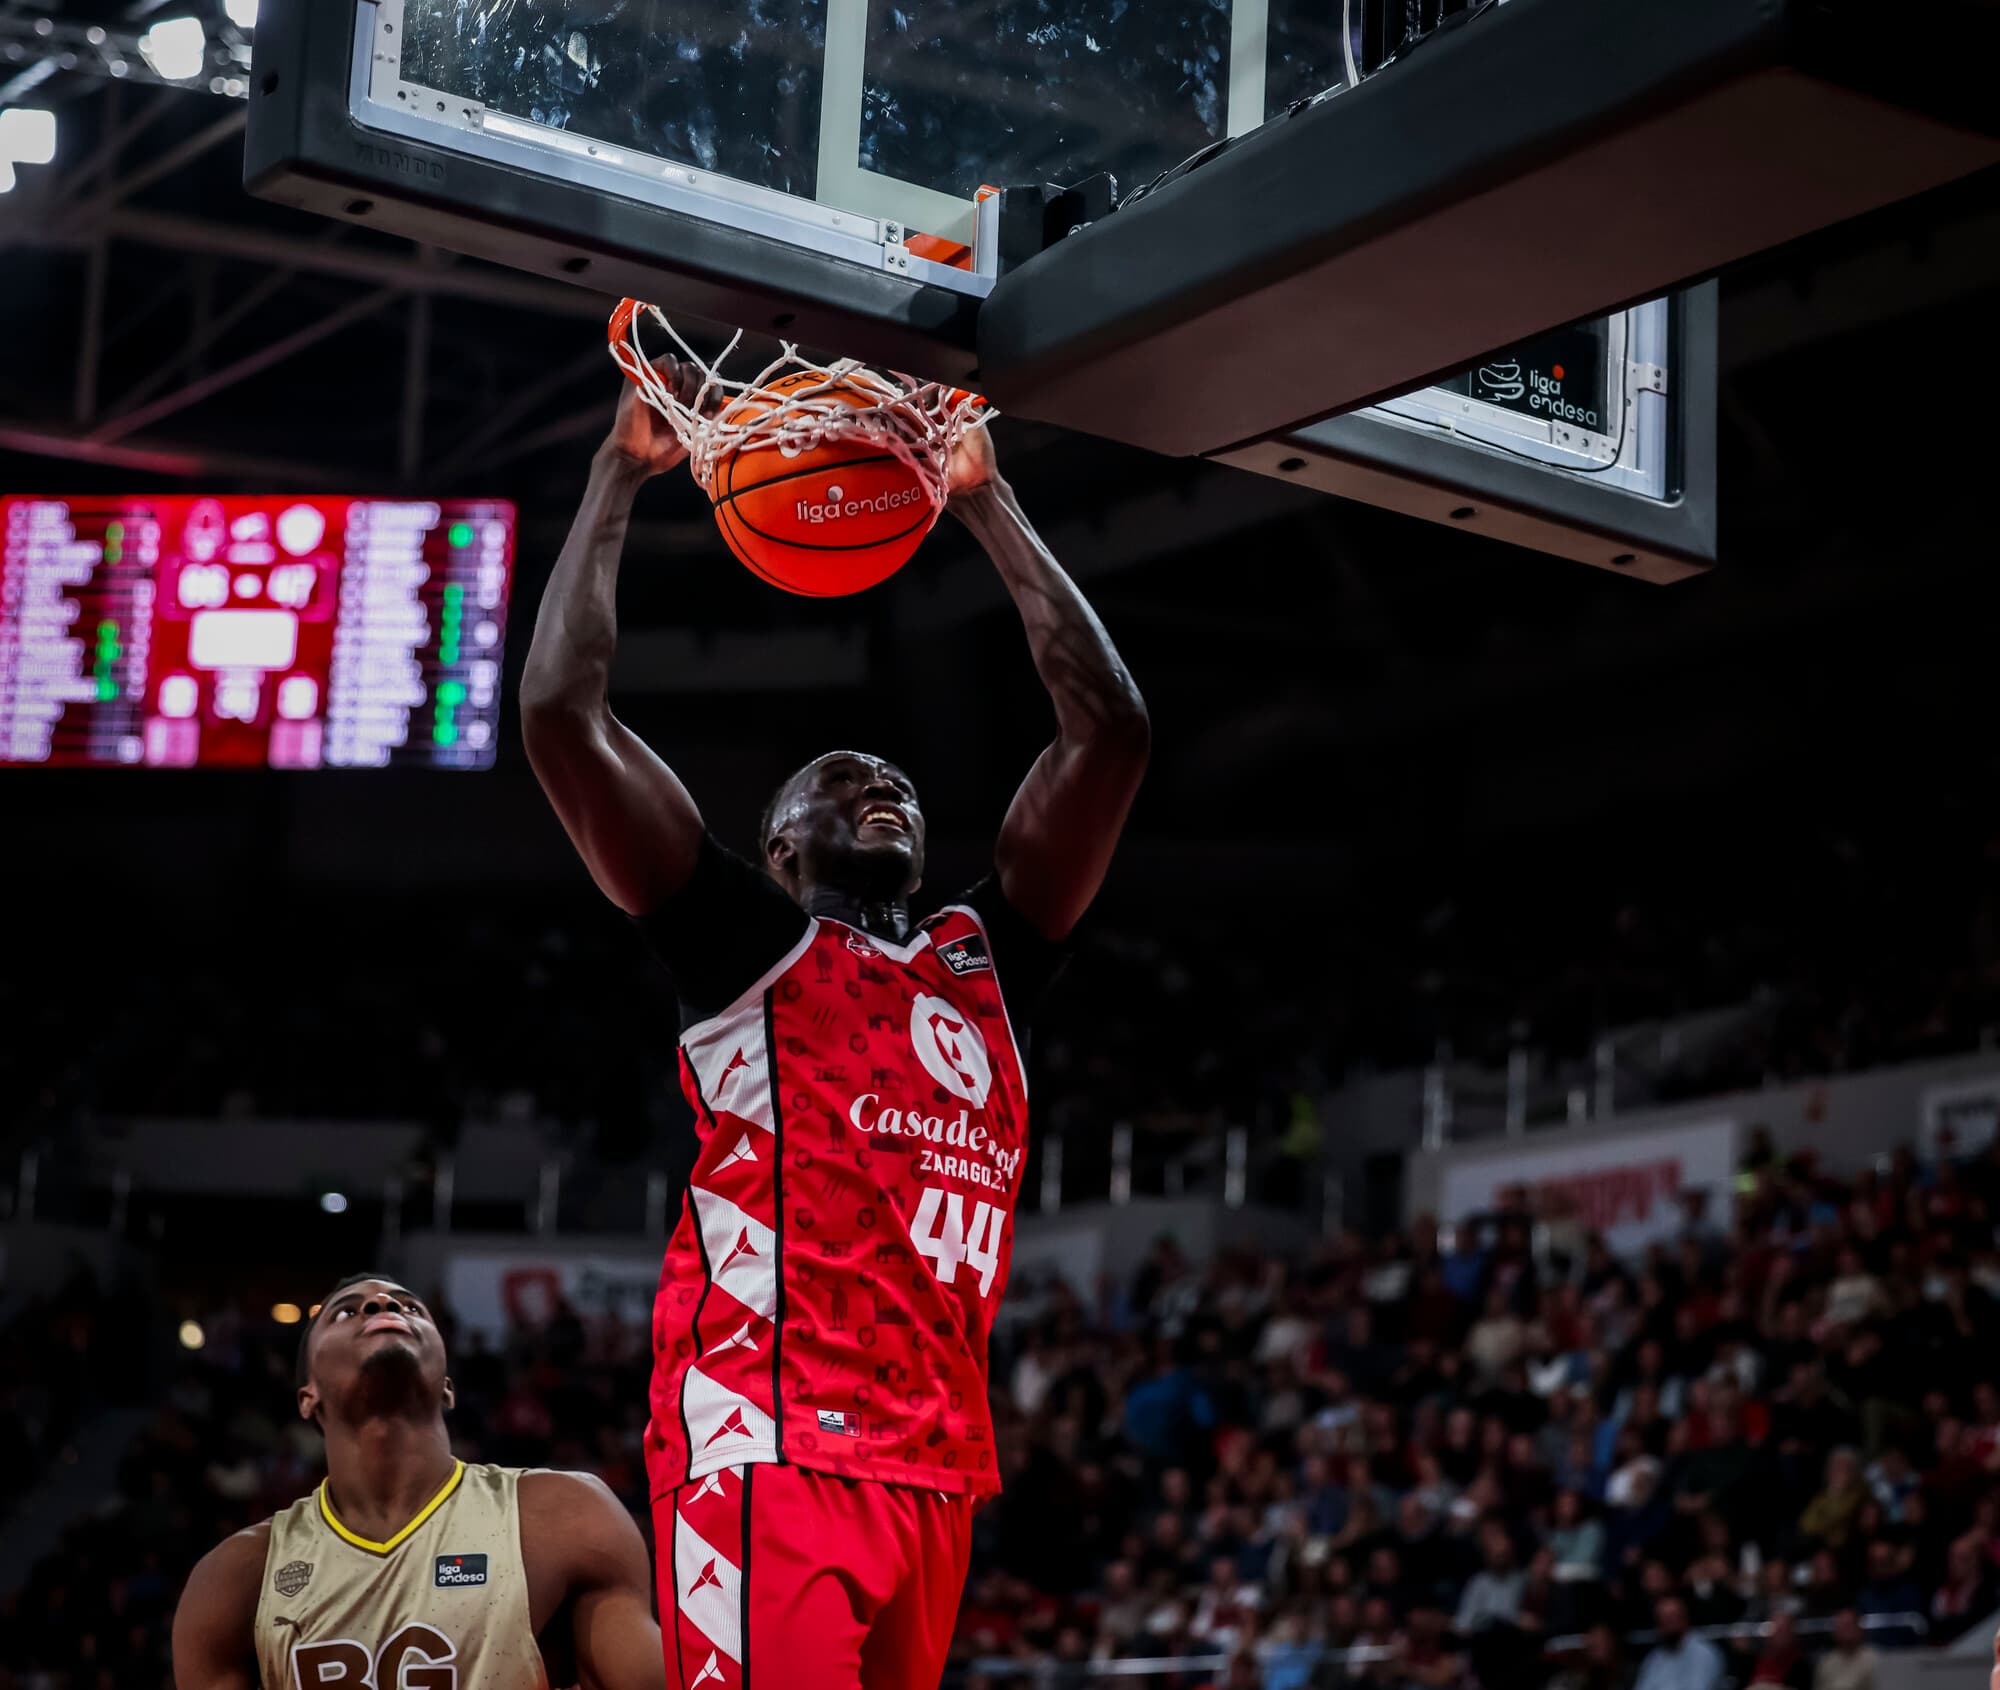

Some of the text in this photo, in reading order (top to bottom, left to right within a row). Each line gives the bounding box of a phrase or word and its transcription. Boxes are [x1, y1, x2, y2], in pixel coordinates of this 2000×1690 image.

[1530, 367, 1562, 395] liga
[1529, 394, 1597, 426] endesa
[797, 494, 841, 523] liga
[844, 486, 921, 516] endesa
[946, 950, 968, 962] liga
[920, 1150, 1006, 1192] ZARAGOZ
[909, 1187, 1007, 1298] 44
[439, 1564, 460, 1575] liga
[439, 1572, 485, 1584] endesa
